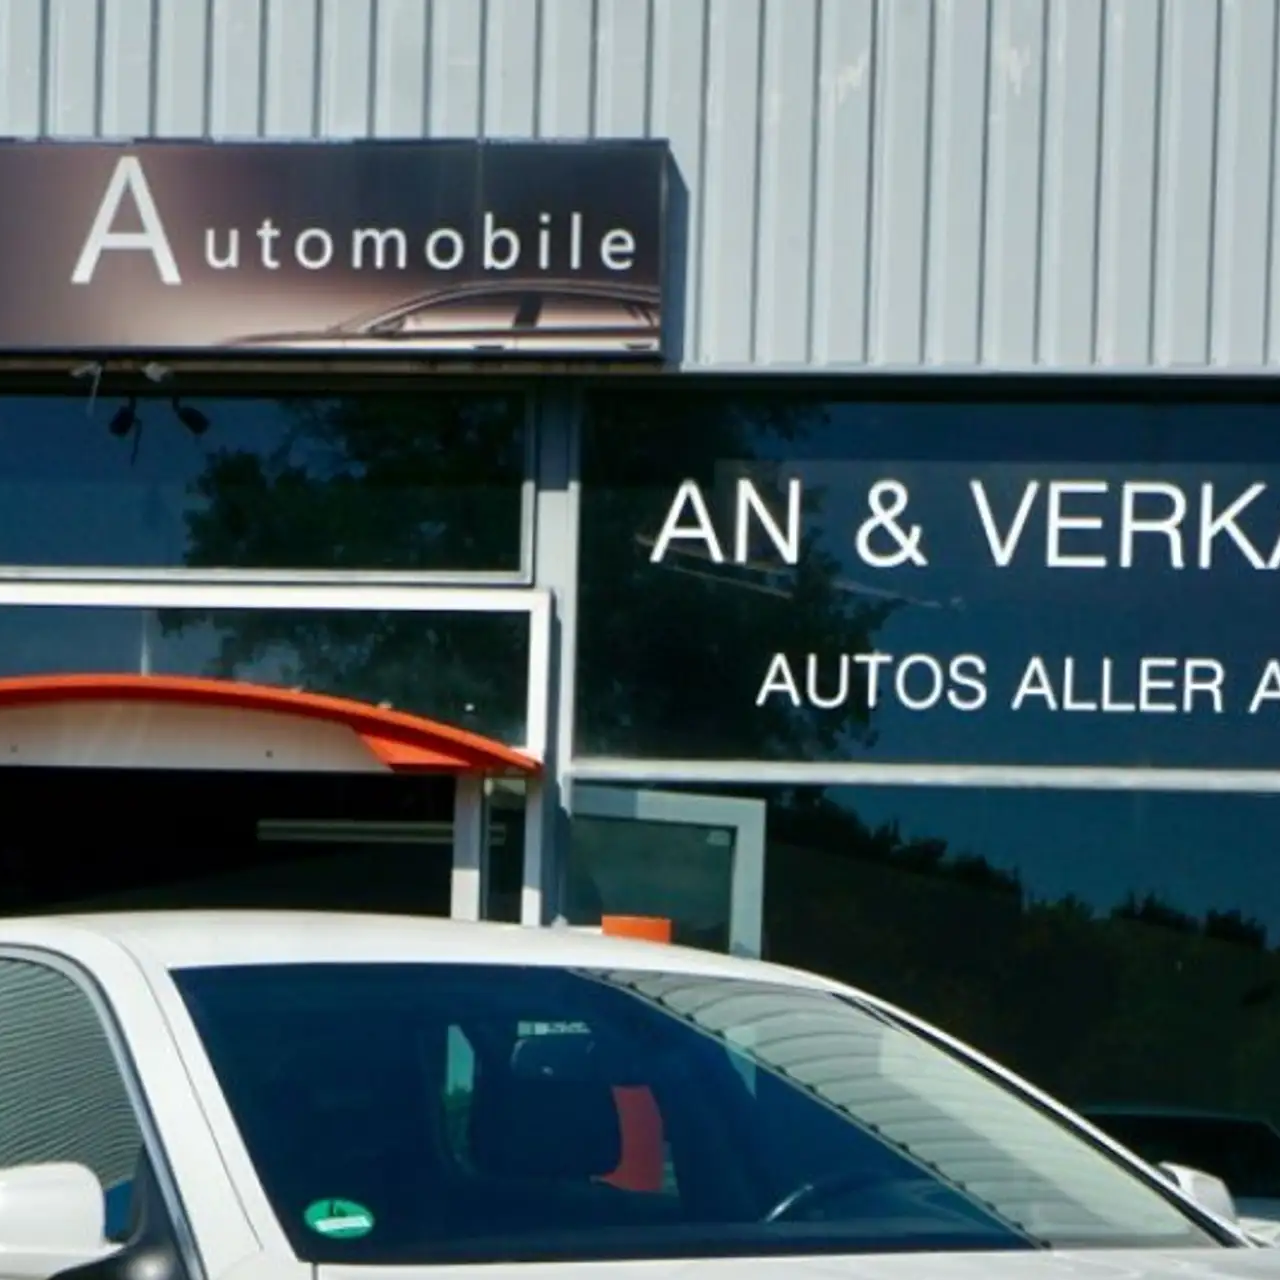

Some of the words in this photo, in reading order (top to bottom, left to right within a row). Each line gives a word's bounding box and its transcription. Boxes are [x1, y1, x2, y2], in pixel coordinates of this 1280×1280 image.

[70, 155, 635, 285] Automobile
[649, 478, 801, 565] AN
[855, 479, 928, 567] &
[755, 652, 987, 711] AUTOS
[1011, 656, 1225, 712] ALLER
